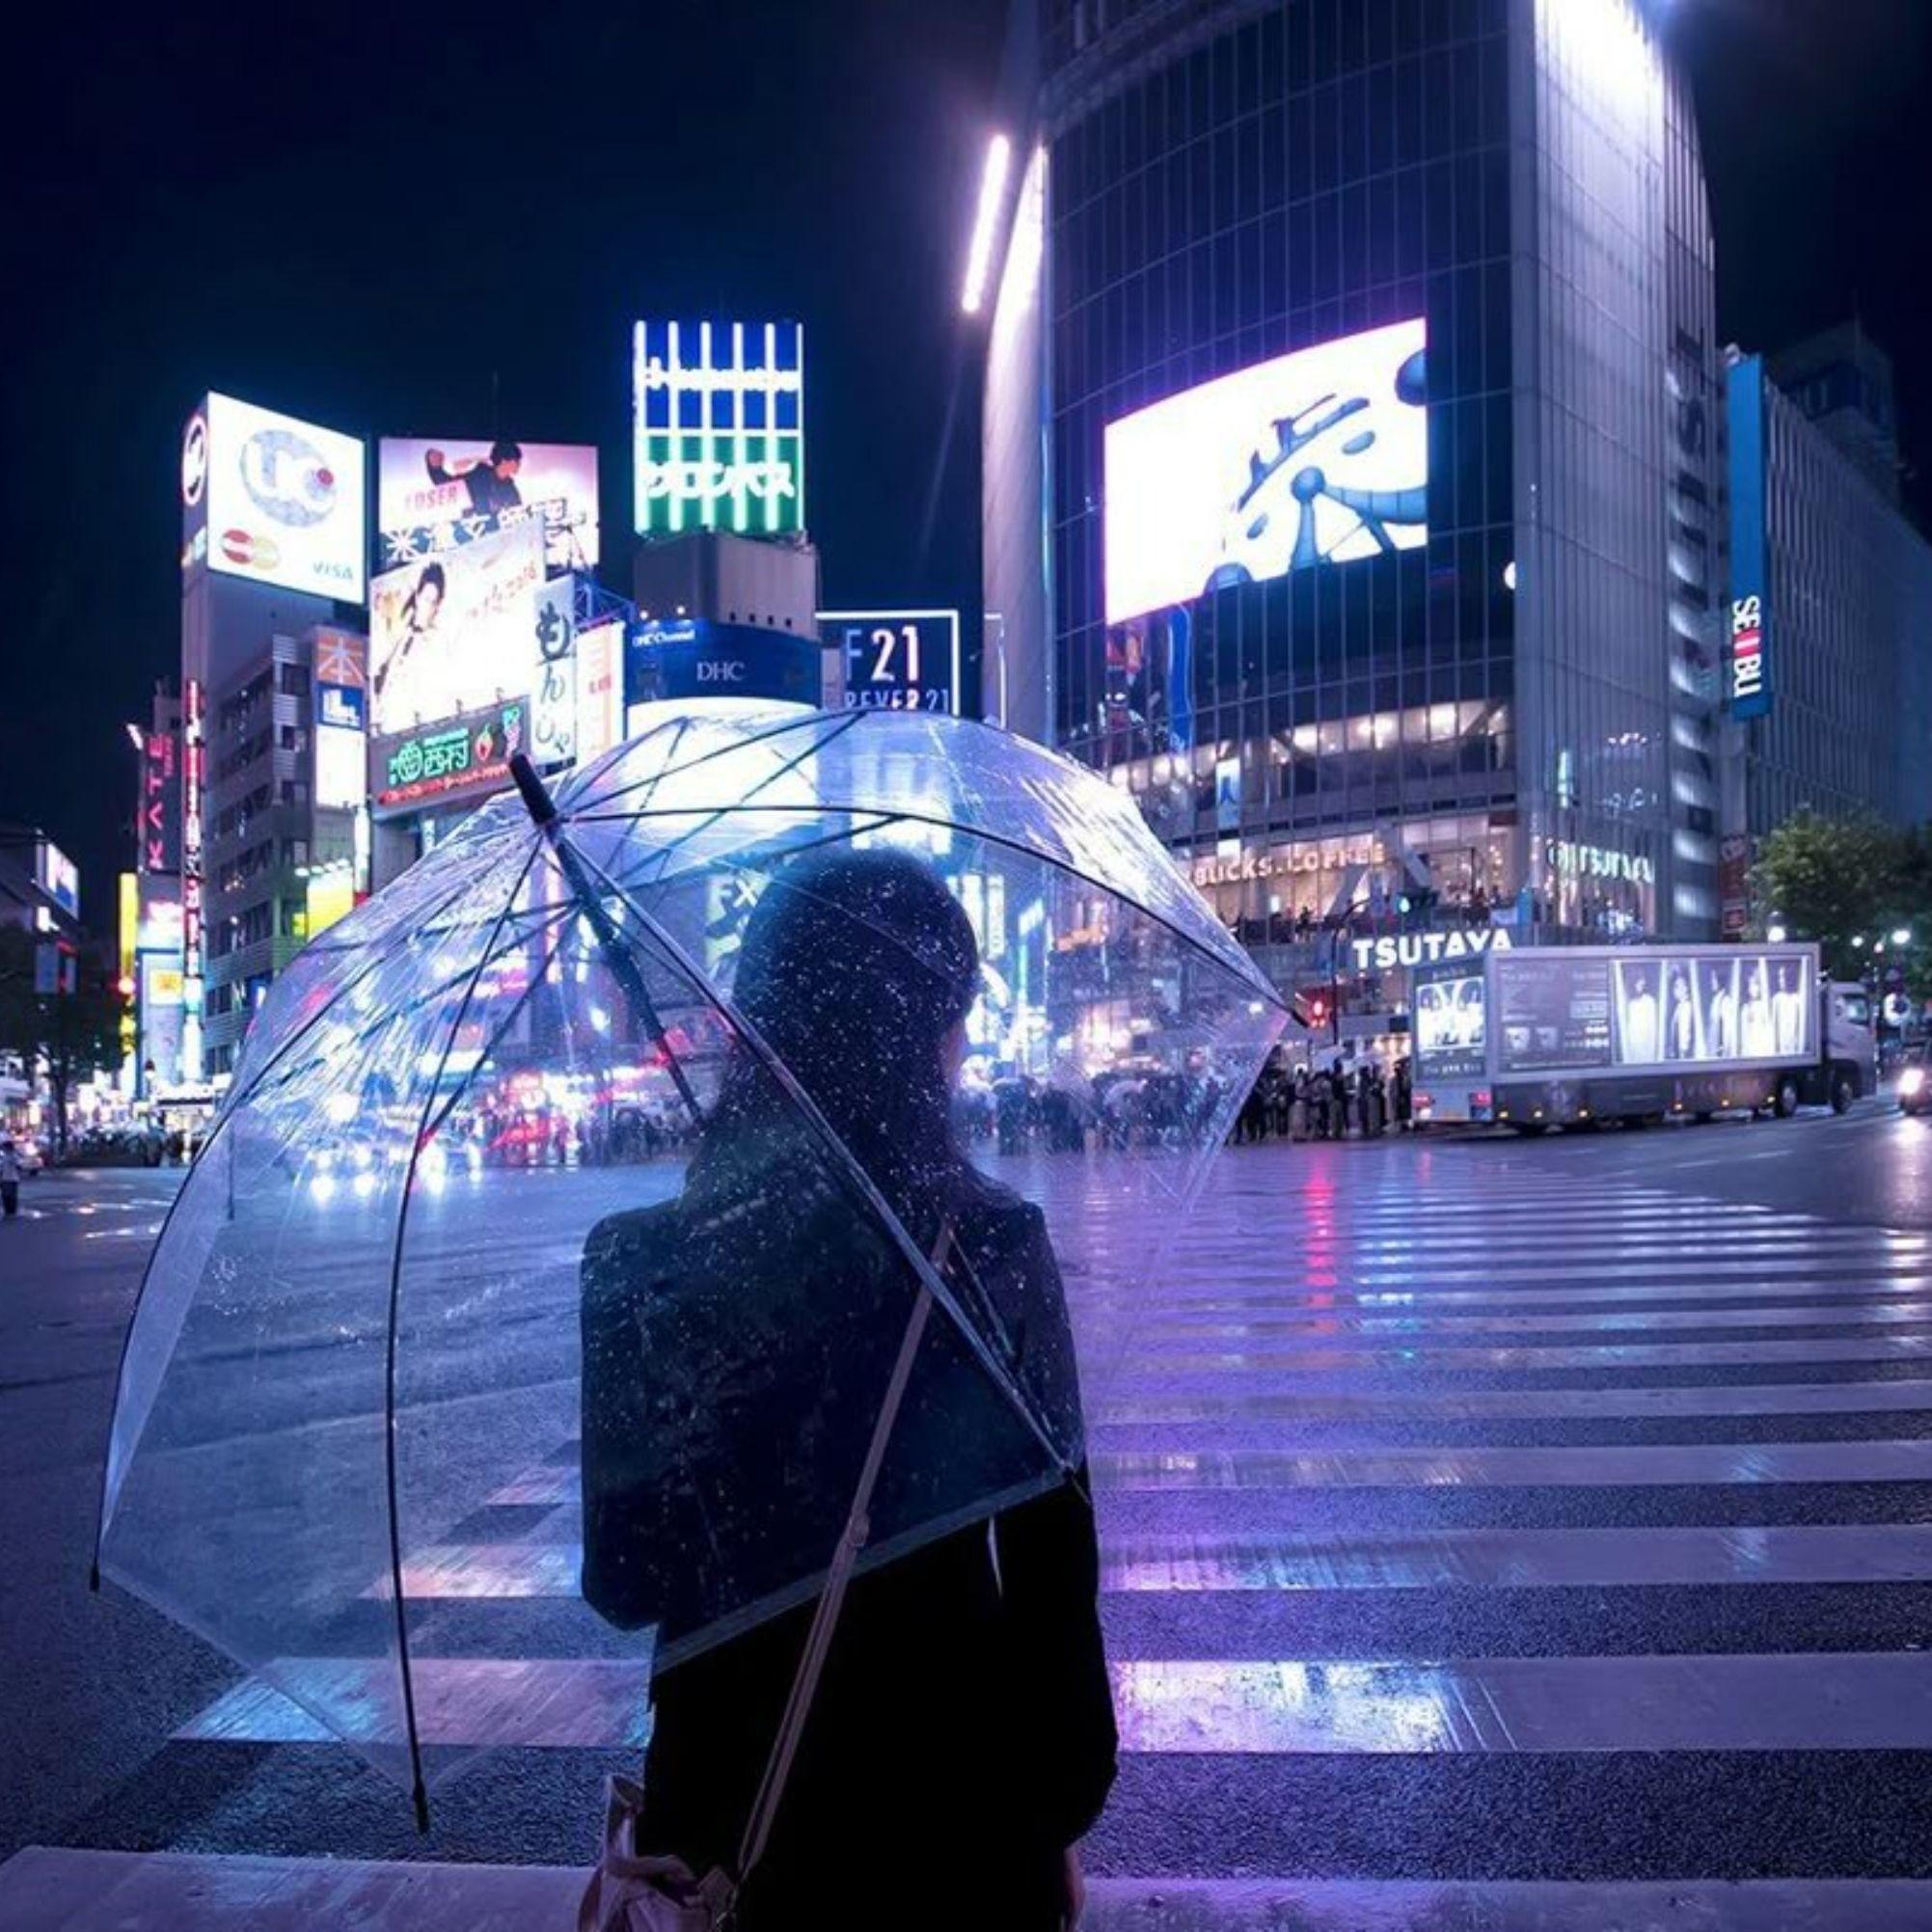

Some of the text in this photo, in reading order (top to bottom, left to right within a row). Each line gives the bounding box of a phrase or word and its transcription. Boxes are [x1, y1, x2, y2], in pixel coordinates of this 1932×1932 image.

[313, 561, 354, 580] VISA
[1733, 595, 1761, 697] SEIBU
[696, 660, 746, 682] DHC
[1351, 927, 1512, 969] TSUTAYA
